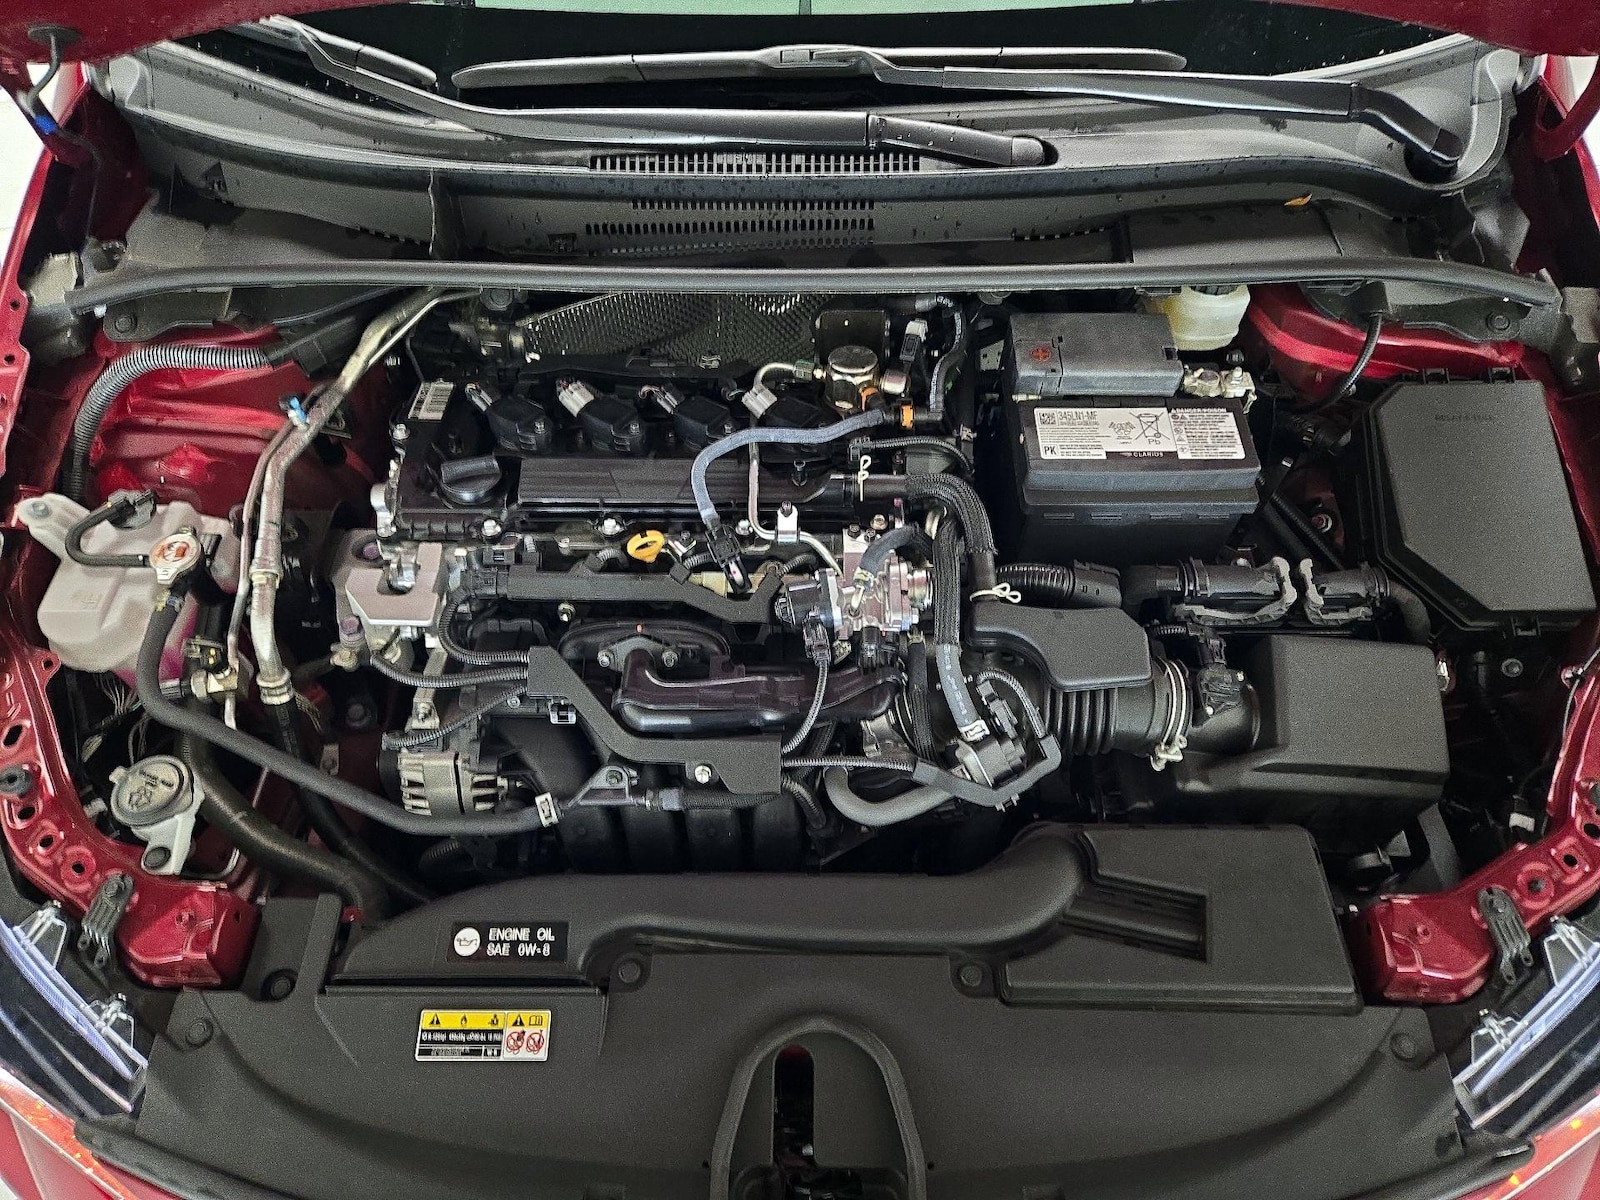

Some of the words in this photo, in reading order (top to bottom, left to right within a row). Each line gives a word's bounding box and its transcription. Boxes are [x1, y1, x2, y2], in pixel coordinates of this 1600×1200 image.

[1043, 445, 1057, 456] PK
[488, 927, 530, 941] ENGINE
[536, 927, 555, 941] OIL
[486, 942, 510, 957] SAE
[517, 942, 551, 957] 0W-8
